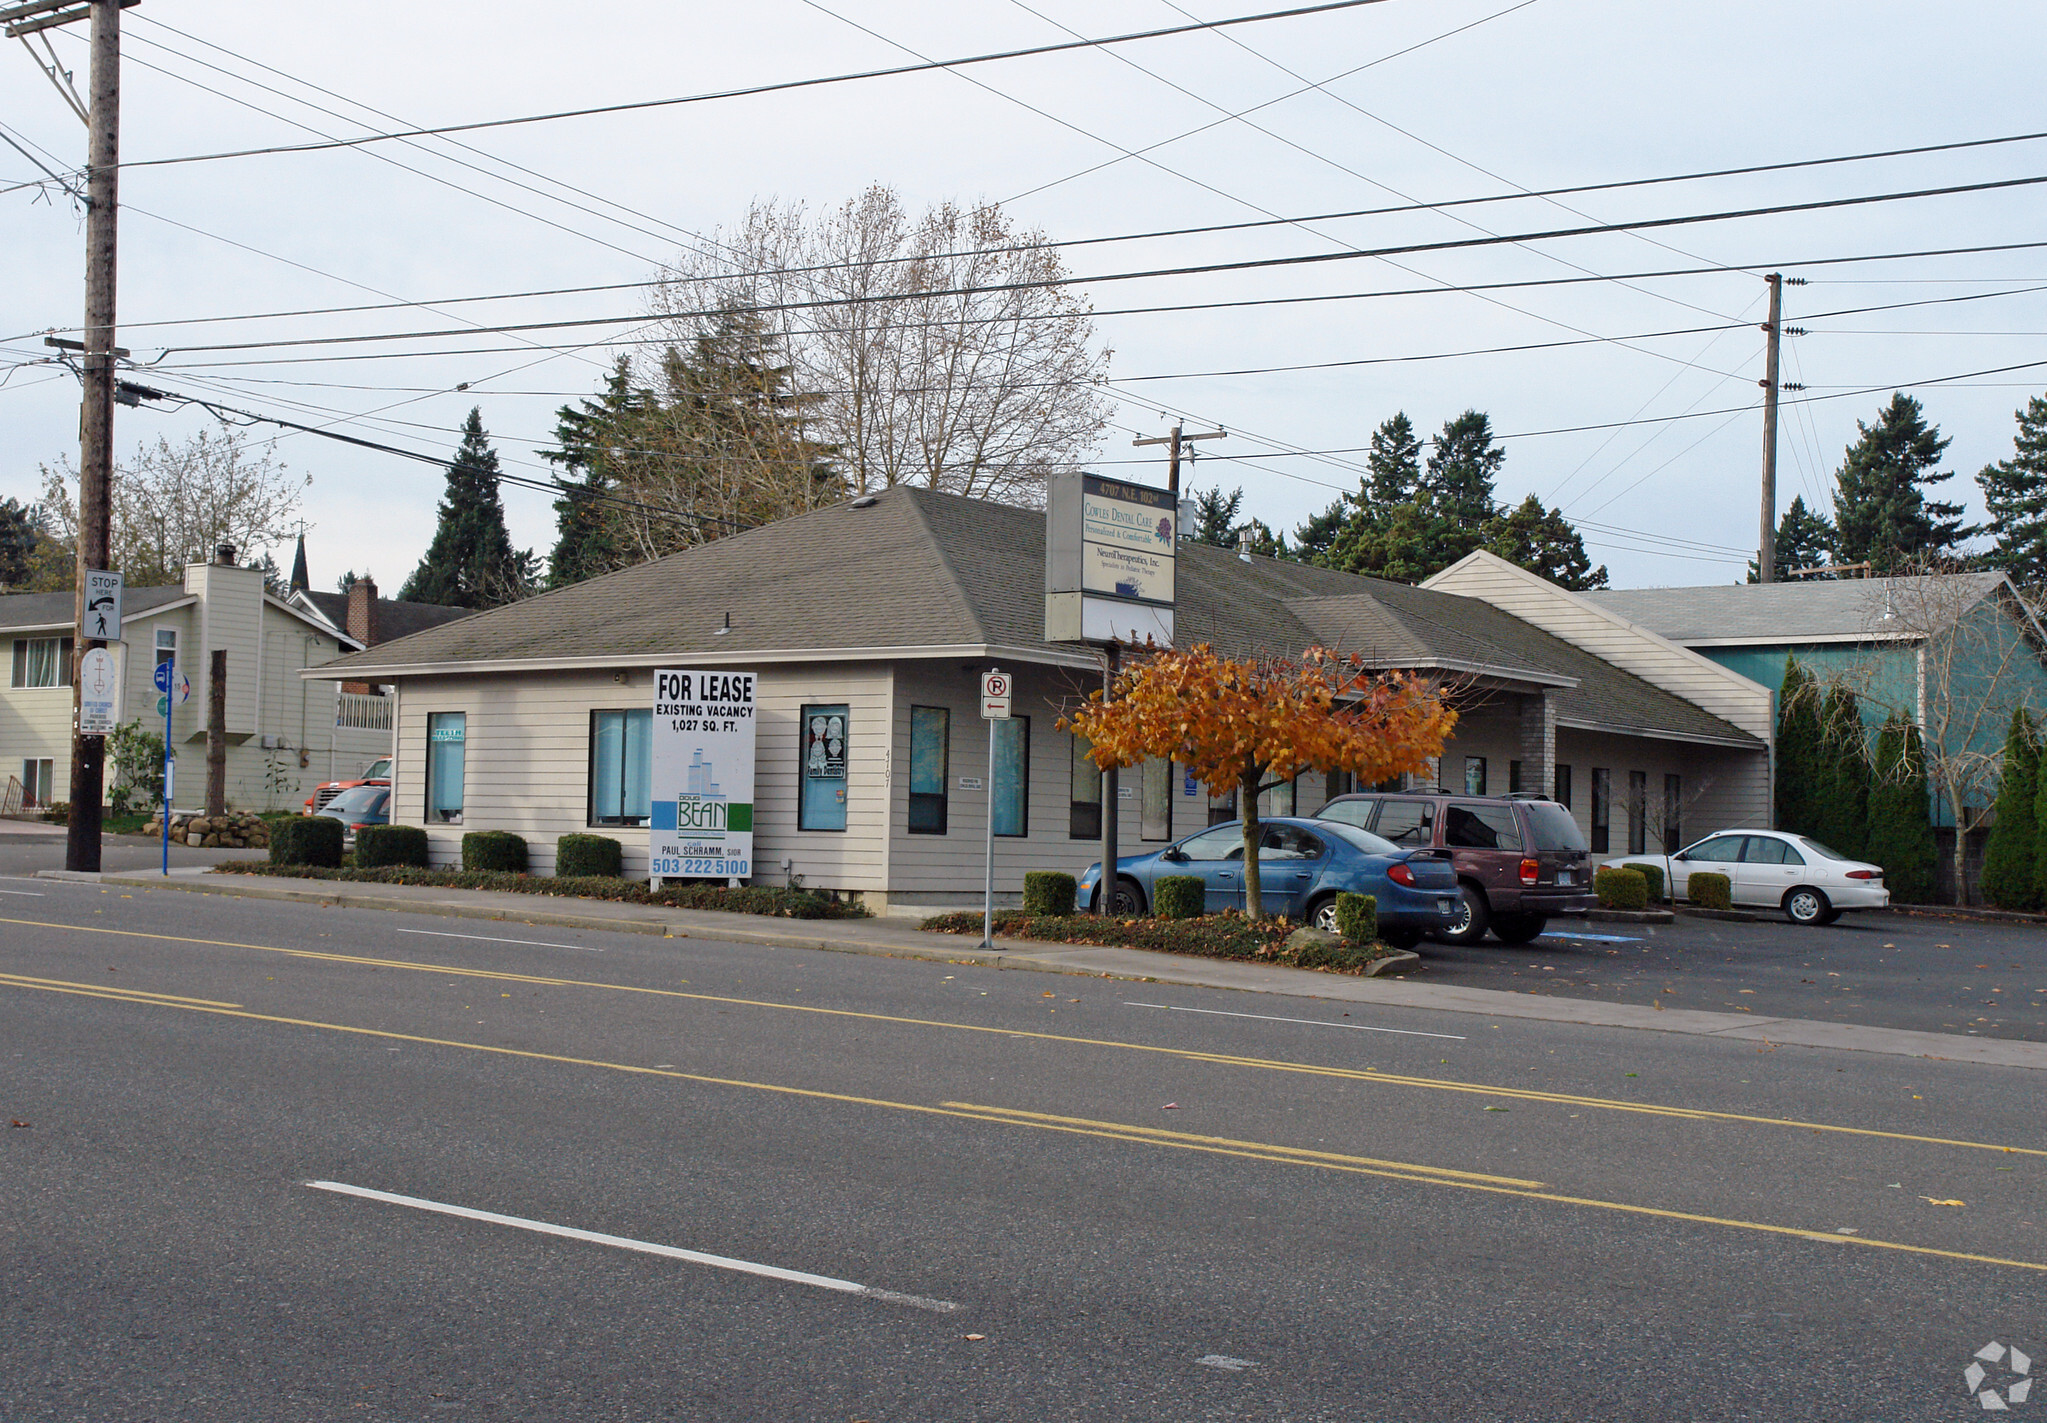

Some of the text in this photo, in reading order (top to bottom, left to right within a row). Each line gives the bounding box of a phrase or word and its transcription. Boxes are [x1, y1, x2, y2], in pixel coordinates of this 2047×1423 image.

[1100, 482, 1120, 498] 4707
[1122, 487, 1138, 500] N.E.
[1084, 502, 1152, 528] COWLES DENTAL CARE
[1085, 523, 1115, 537] Personalized
[1122, 530, 1152, 544] Comfortable
[1150, 557, 1160, 567] Inc.
[92, 577, 118, 588] STOP
[659, 674, 752, 702] FOR LEASE
[656, 704, 753, 718] EXISTING VACANCY
[672, 720, 737, 733] 1,027 SQ. FT.
[679, 802, 726, 827] BEAN
[662, 846, 680, 855] PAUL
